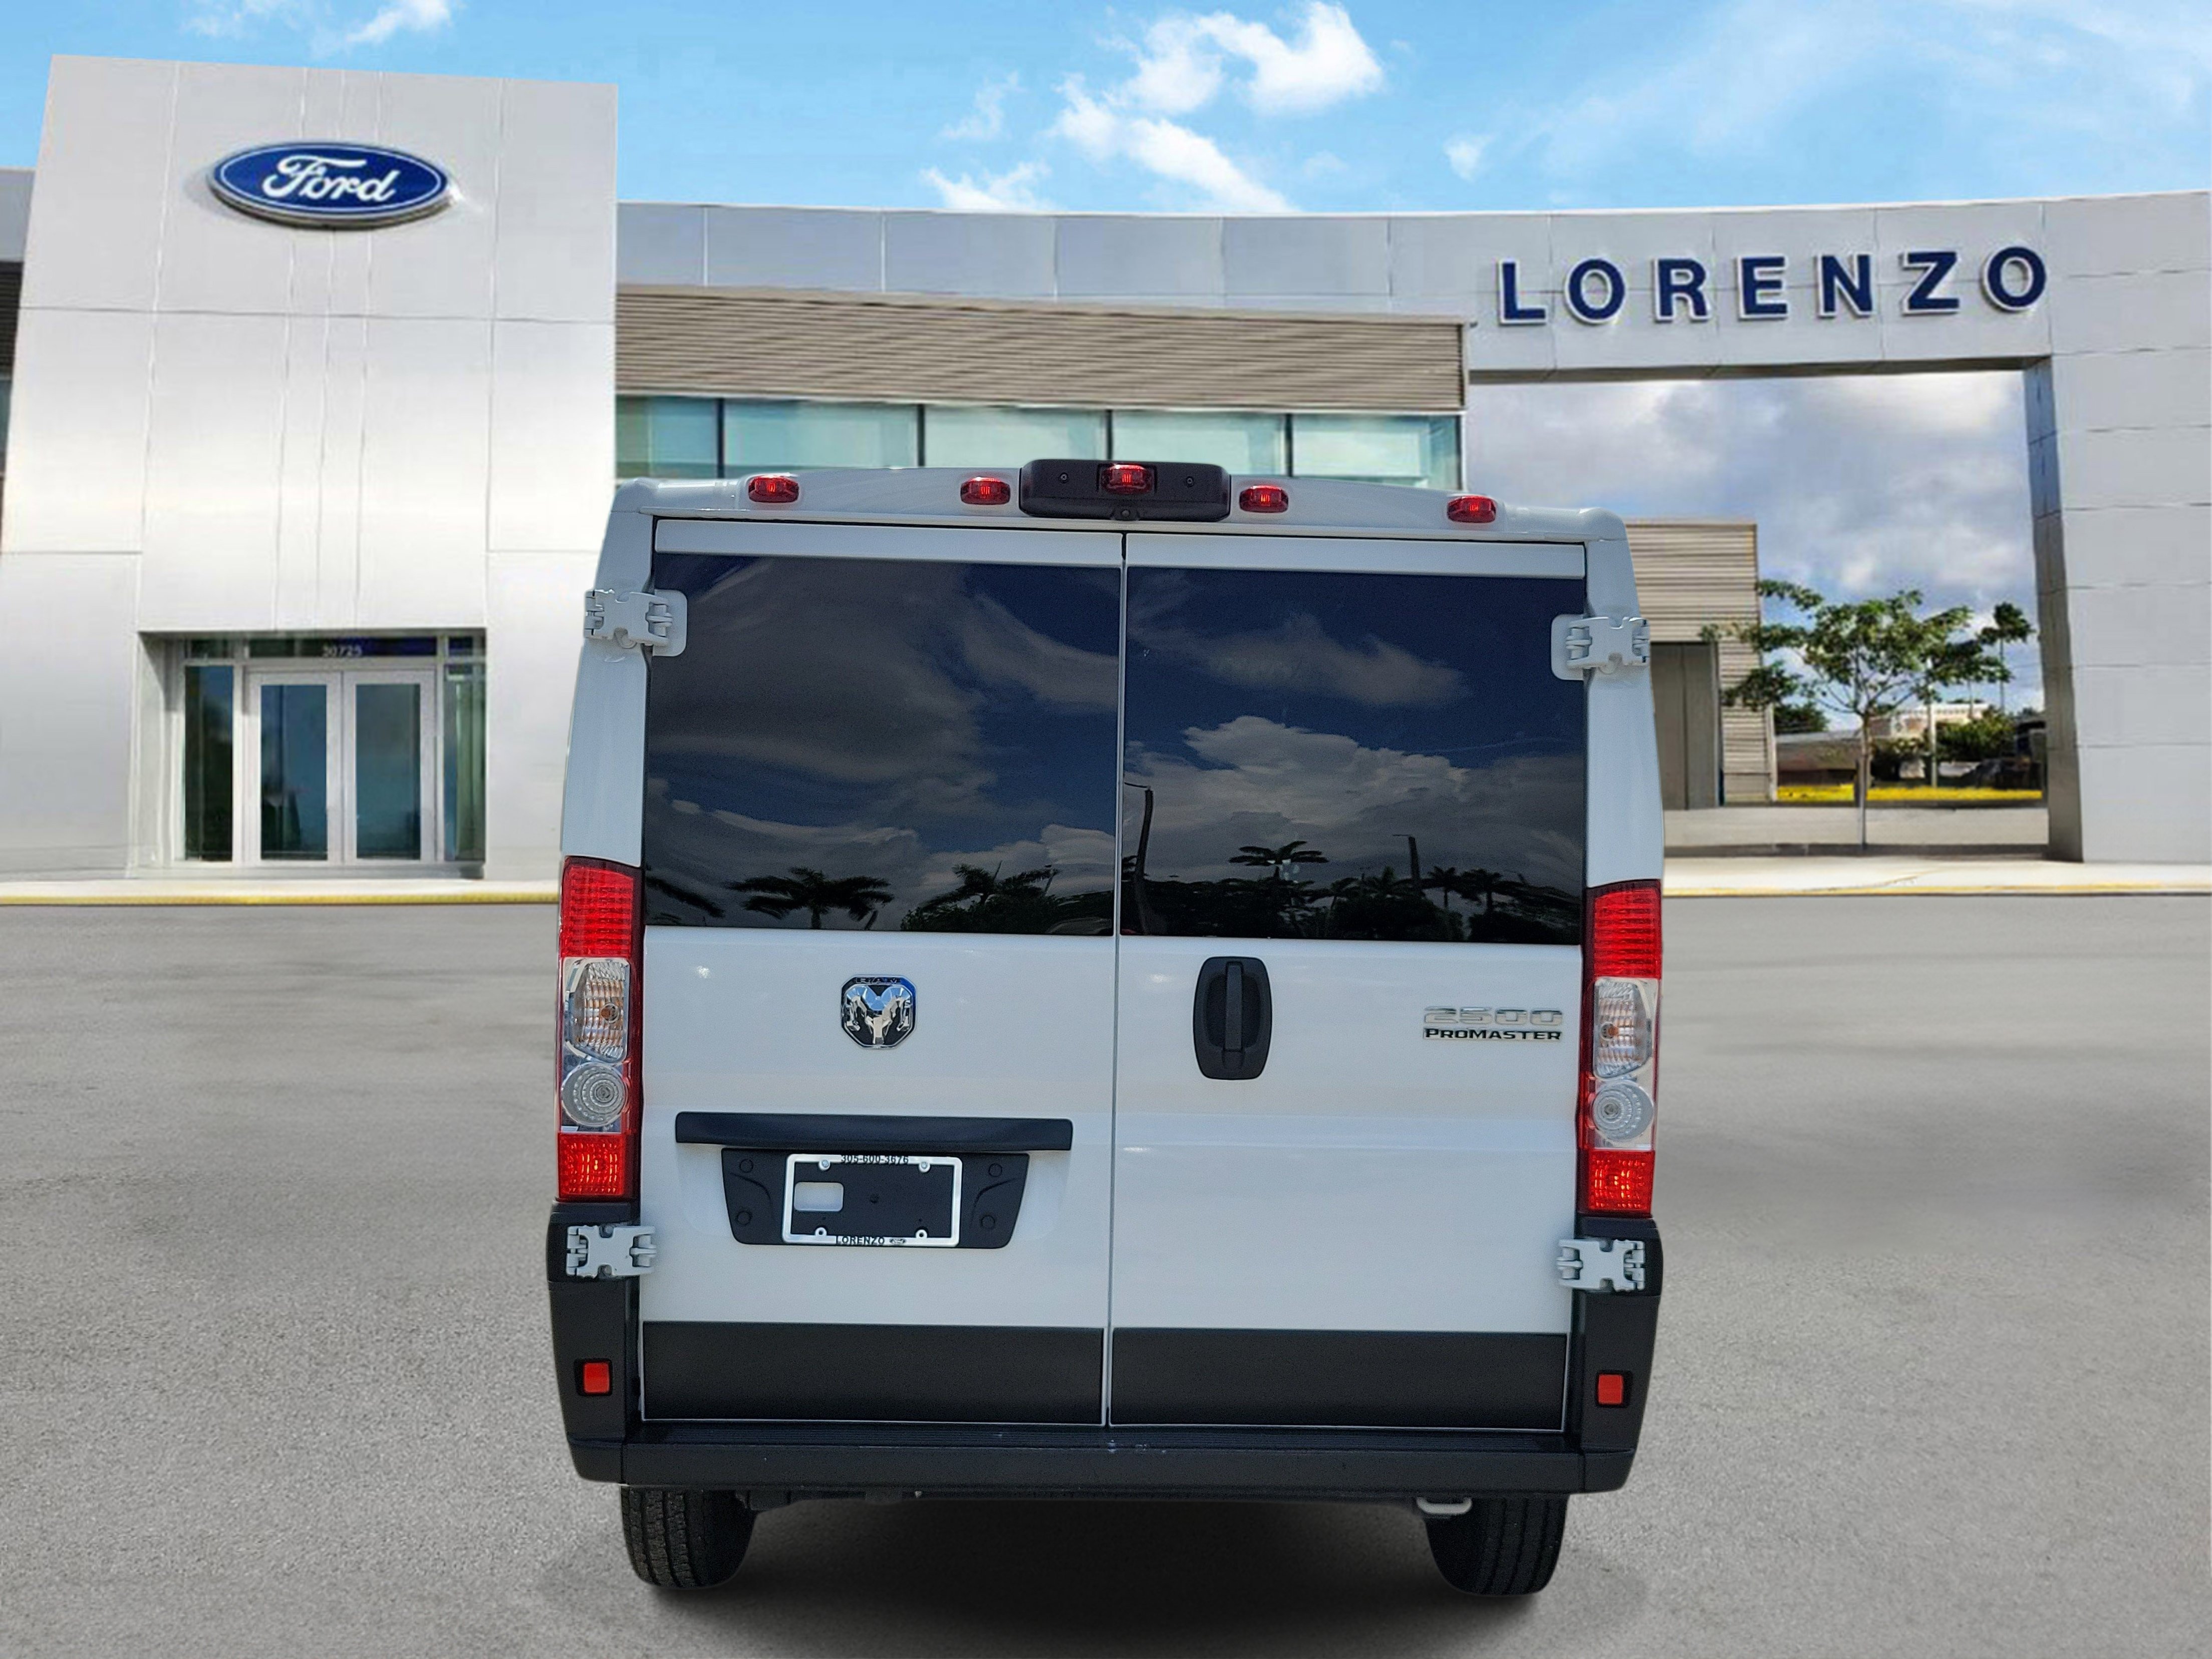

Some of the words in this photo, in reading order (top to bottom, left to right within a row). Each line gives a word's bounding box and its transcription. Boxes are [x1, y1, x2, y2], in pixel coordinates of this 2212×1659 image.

[262, 154, 400, 202] Ford
[1498, 246, 2048, 326] LORENZO
[1424, 1006, 1563, 1025] 2500
[836, 1235, 885, 1246] LORENZO
